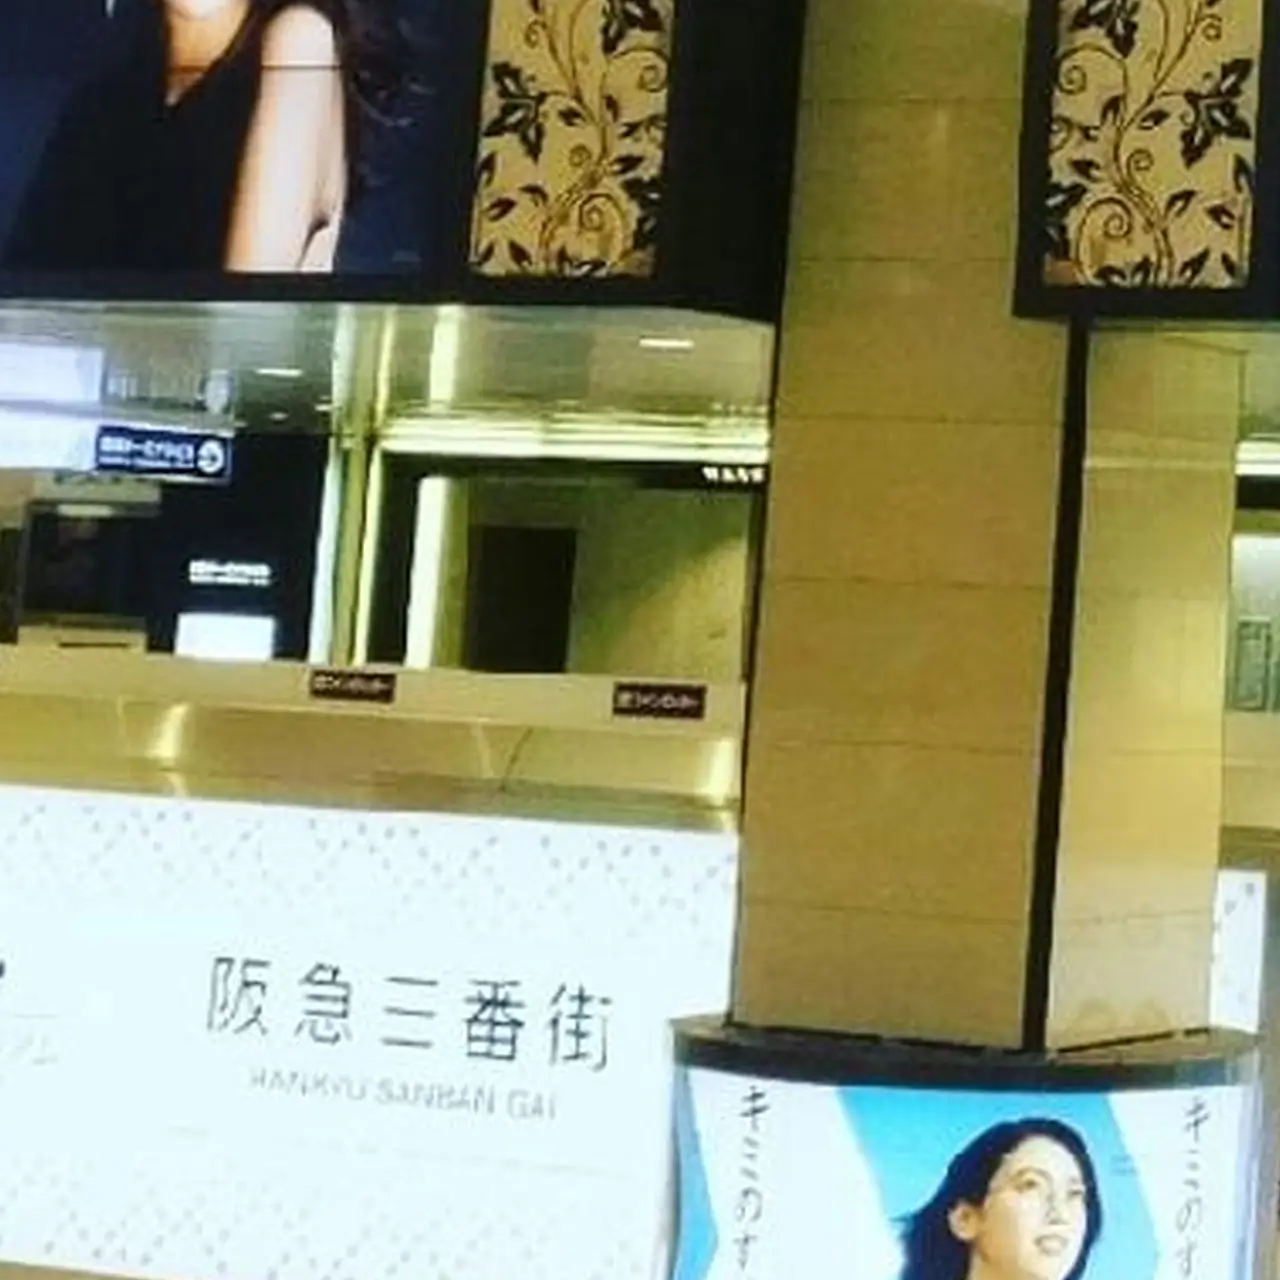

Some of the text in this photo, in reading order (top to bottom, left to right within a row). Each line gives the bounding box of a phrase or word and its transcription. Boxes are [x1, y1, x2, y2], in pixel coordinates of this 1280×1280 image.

[205, 956, 614, 1072] 阪急三番街
